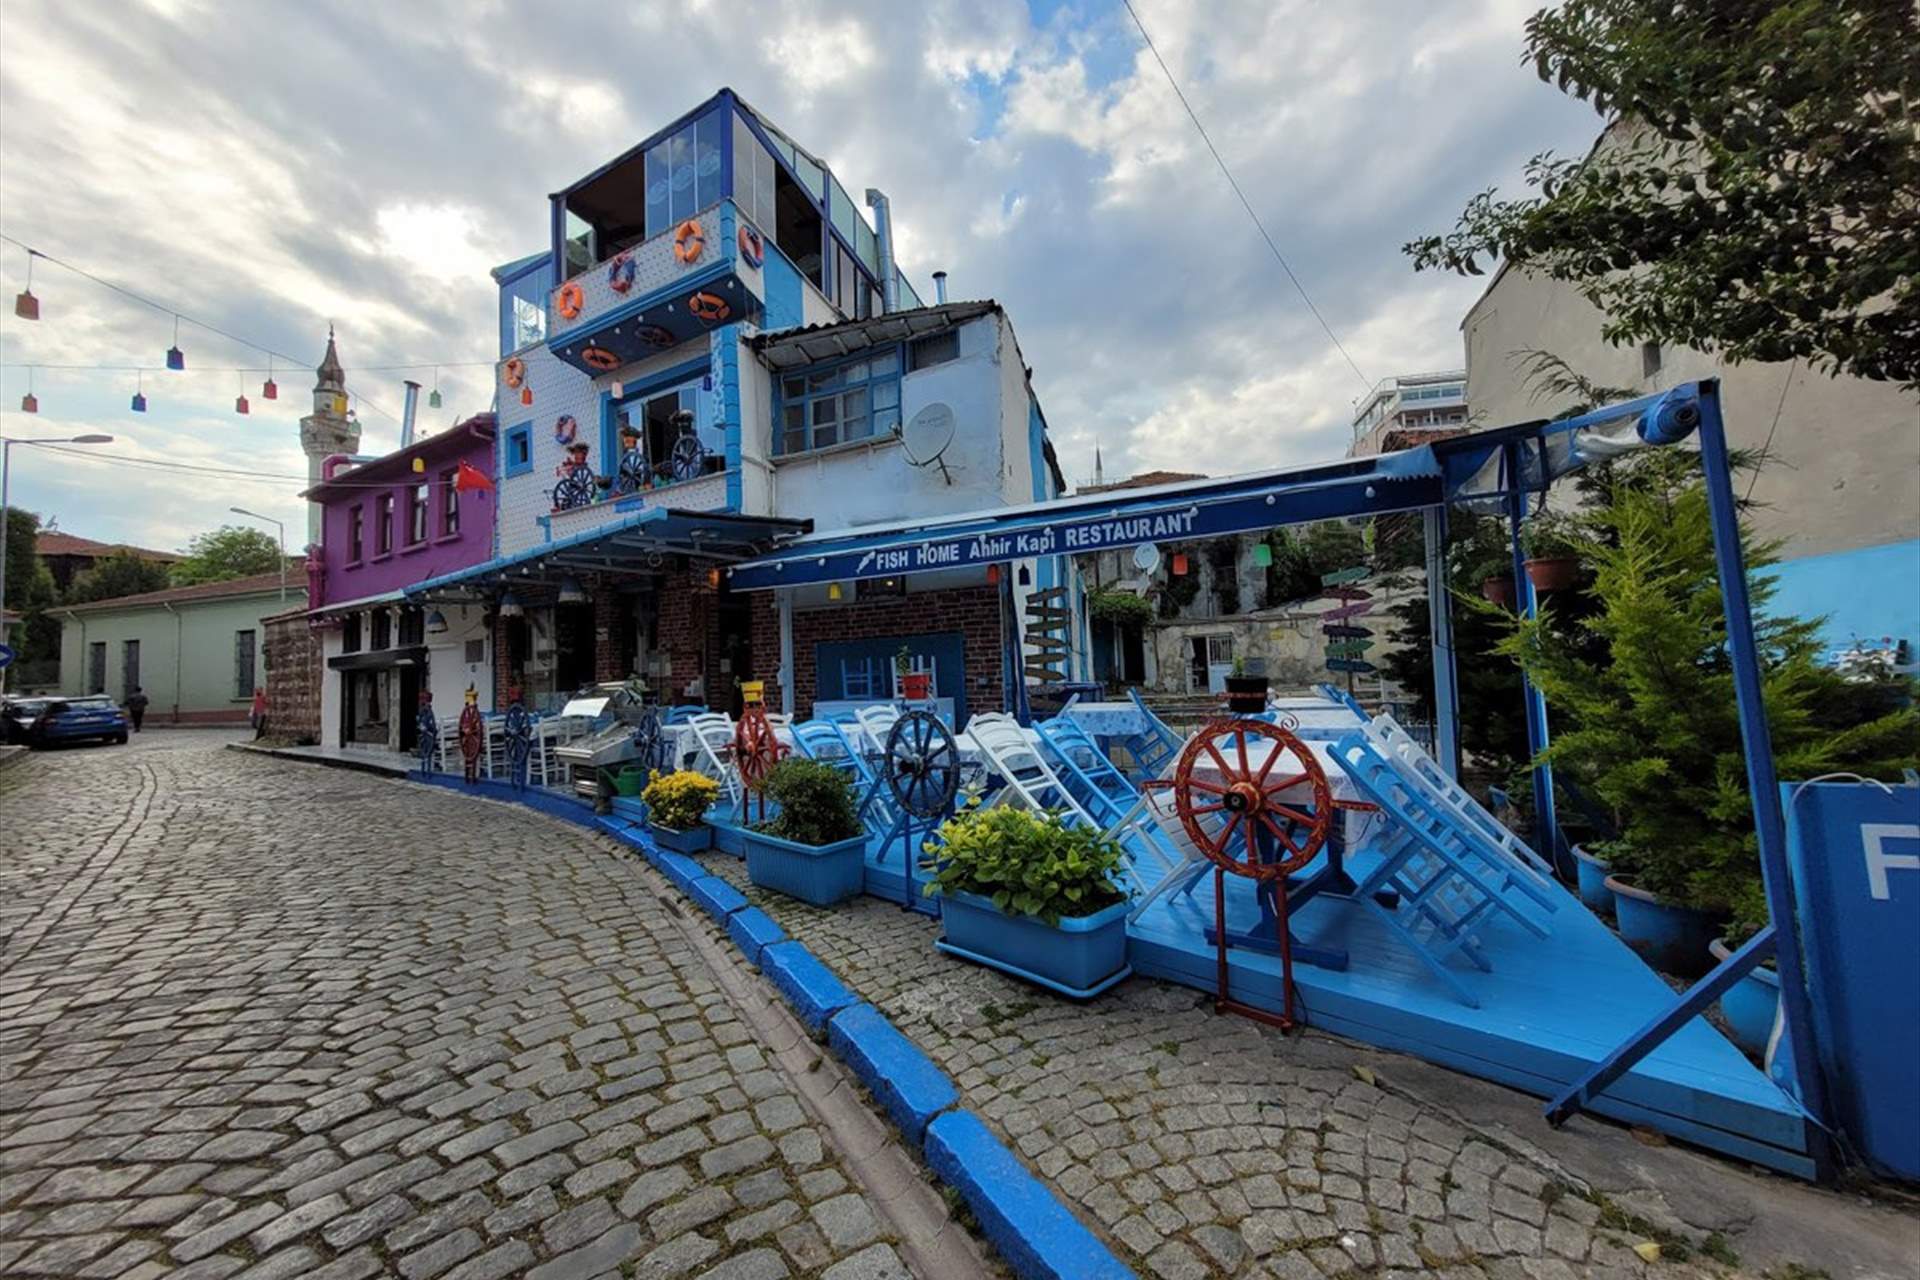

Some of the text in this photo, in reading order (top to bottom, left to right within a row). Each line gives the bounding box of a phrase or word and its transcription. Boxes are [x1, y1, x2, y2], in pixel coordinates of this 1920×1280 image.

[876, 550, 908, 570] FISH
[917, 544, 960, 565] HOME
[1065, 513, 1192, 547] RESTAURANT
[1860, 823, 1920, 899] F
